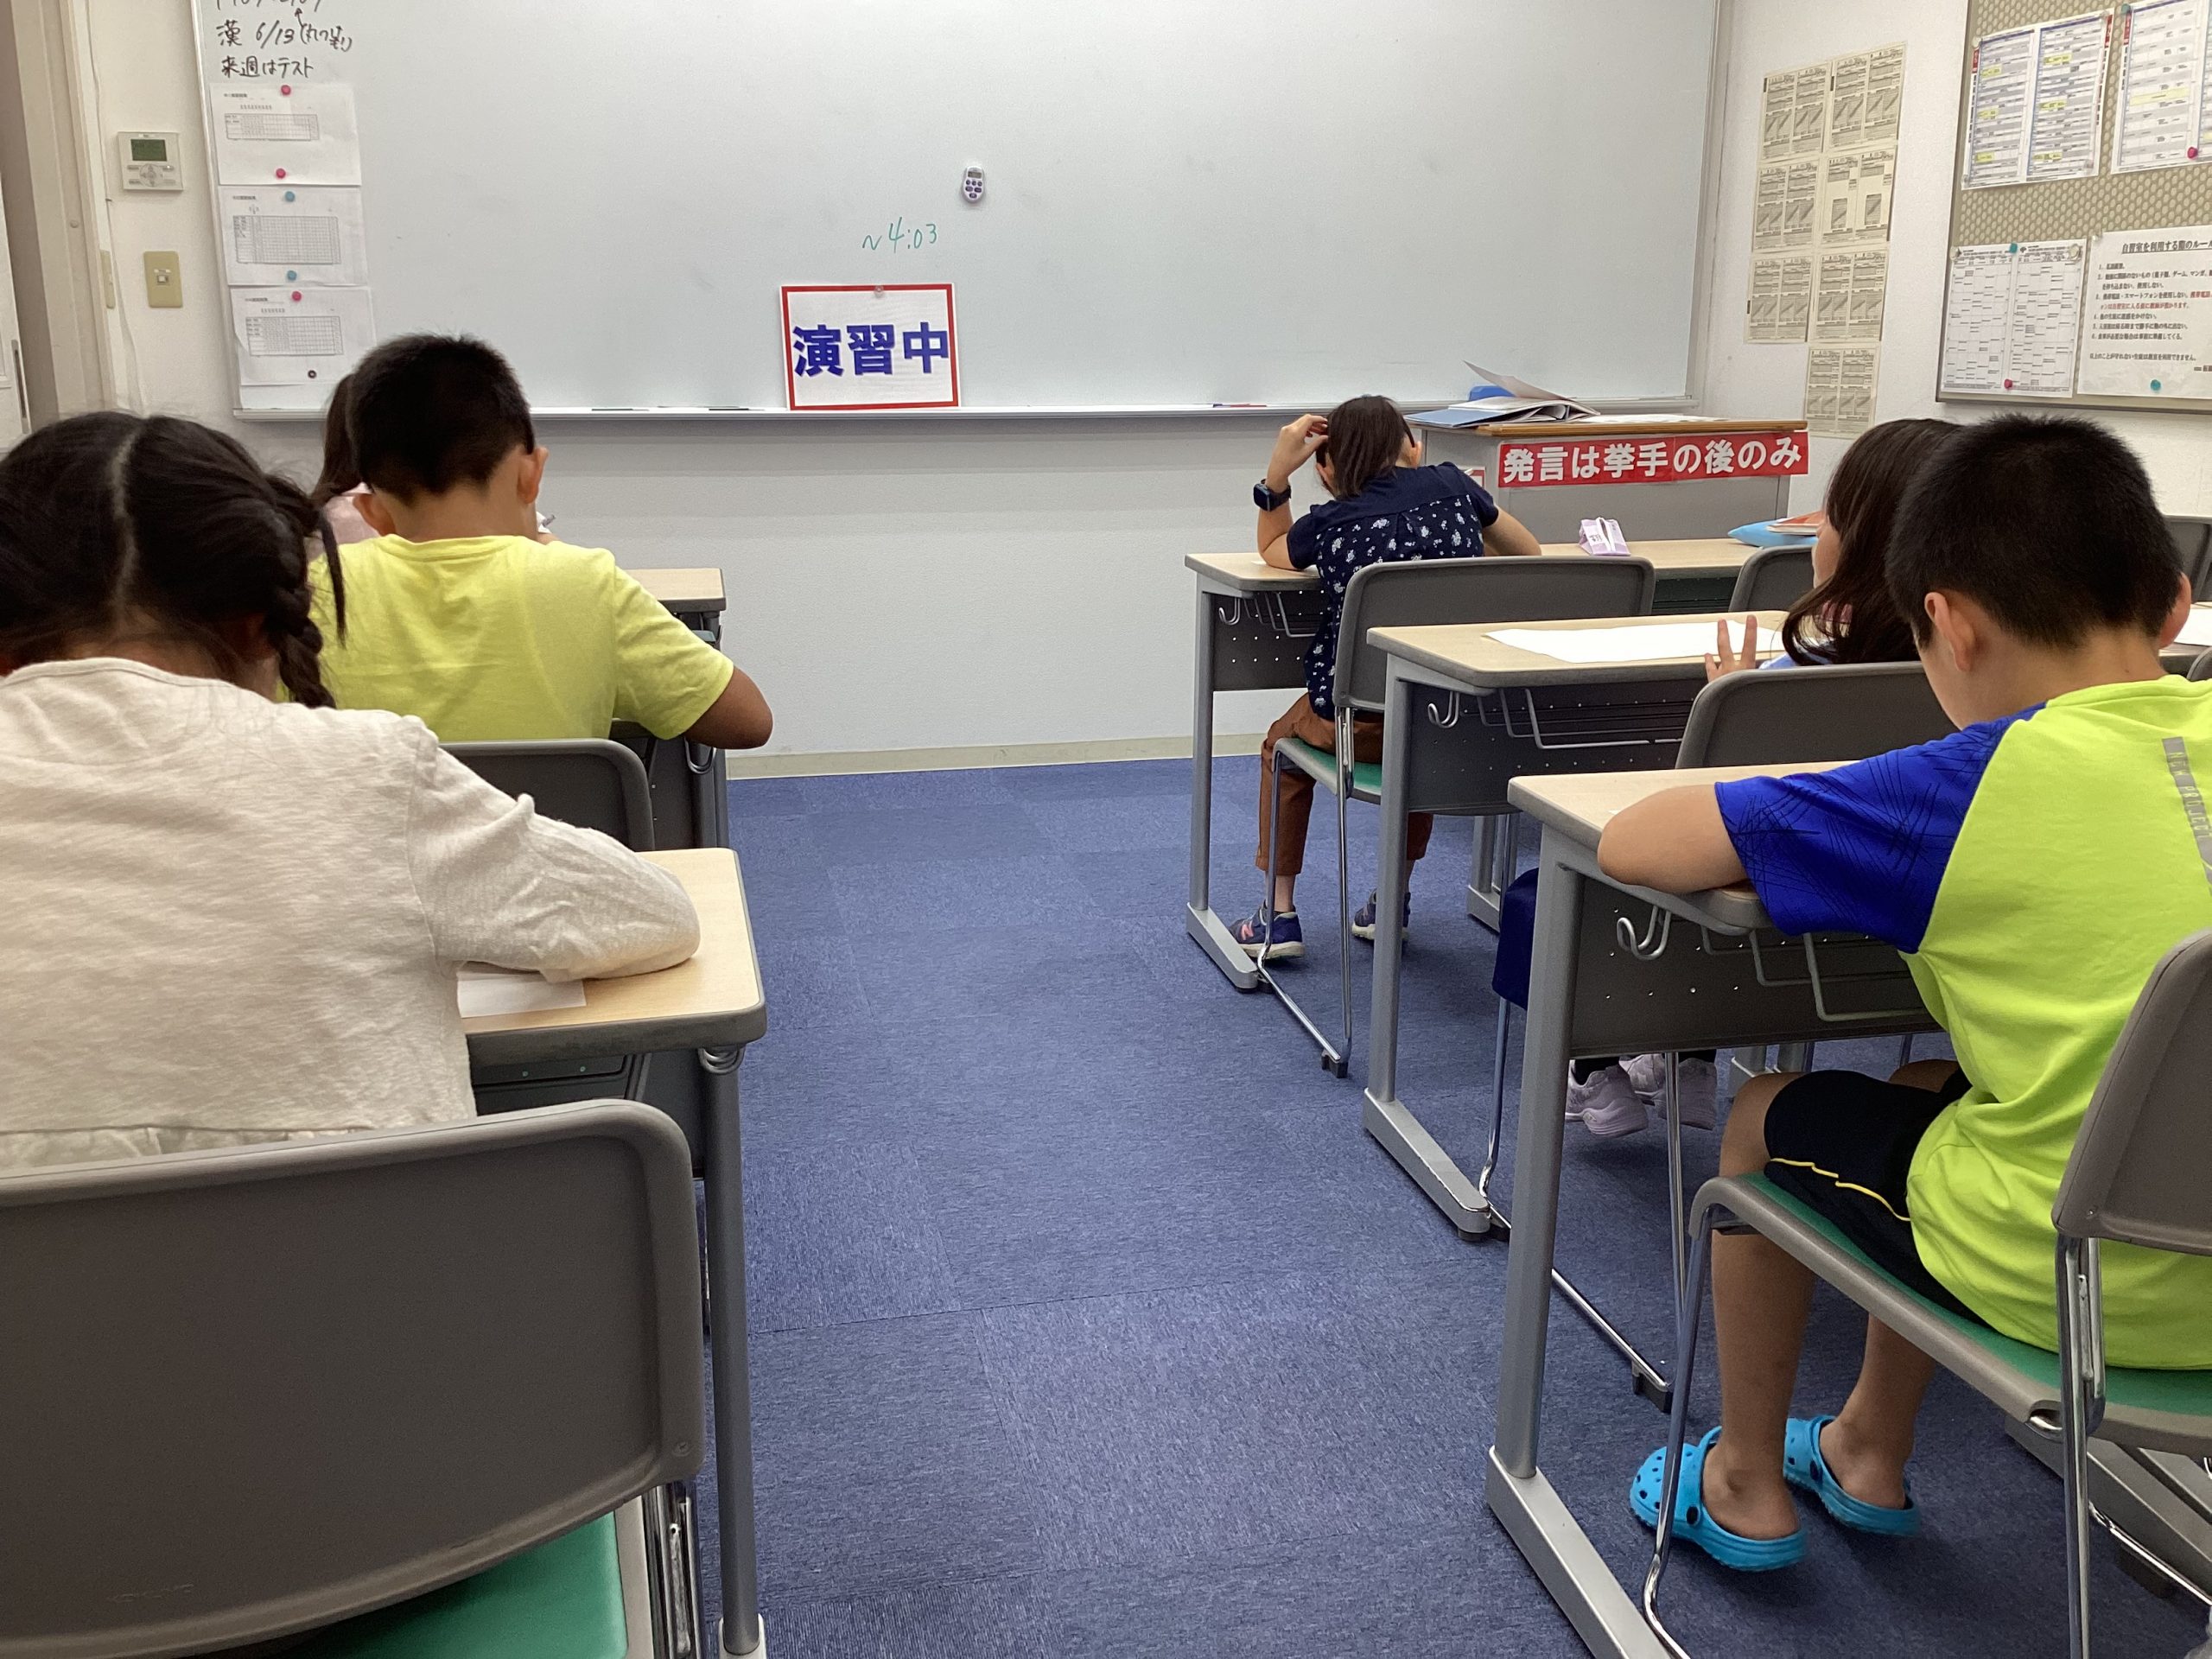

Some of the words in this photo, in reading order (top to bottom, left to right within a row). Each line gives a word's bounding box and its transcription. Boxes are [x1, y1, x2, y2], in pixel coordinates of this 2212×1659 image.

[216, 19, 243, 48] 漢
[256, 20, 295, 49] 6/13
[221, 55, 314, 79] 来週はテスト
[792, 321, 950, 377] 演習中
[1503, 436, 1802, 484] 発言は挙手の後のみ
